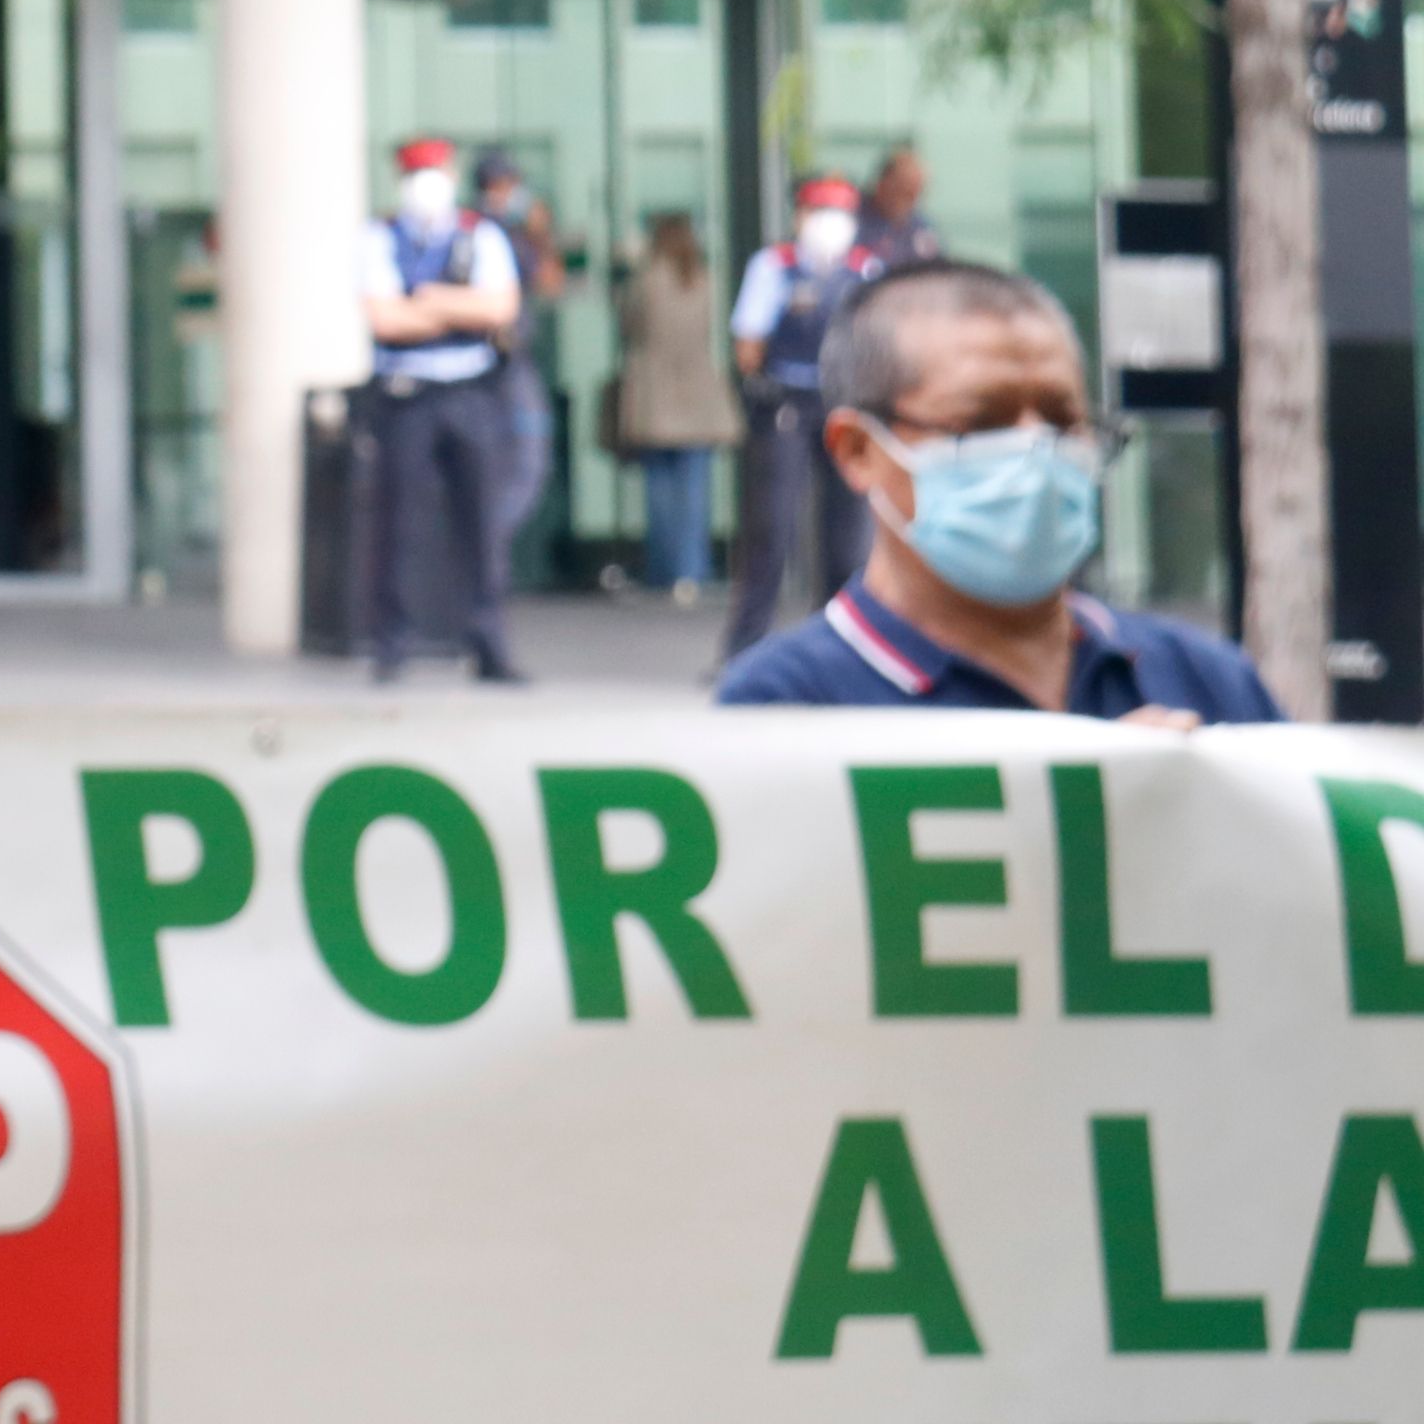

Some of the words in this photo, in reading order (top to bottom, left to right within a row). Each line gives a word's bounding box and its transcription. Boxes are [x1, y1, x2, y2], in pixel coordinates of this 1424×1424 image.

[76, 764, 753, 1028] POR
[846, 764, 1213, 1017] EL
[774, 1117, 985, 1359] A
[1089, 1114, 1424, 1354] LA
